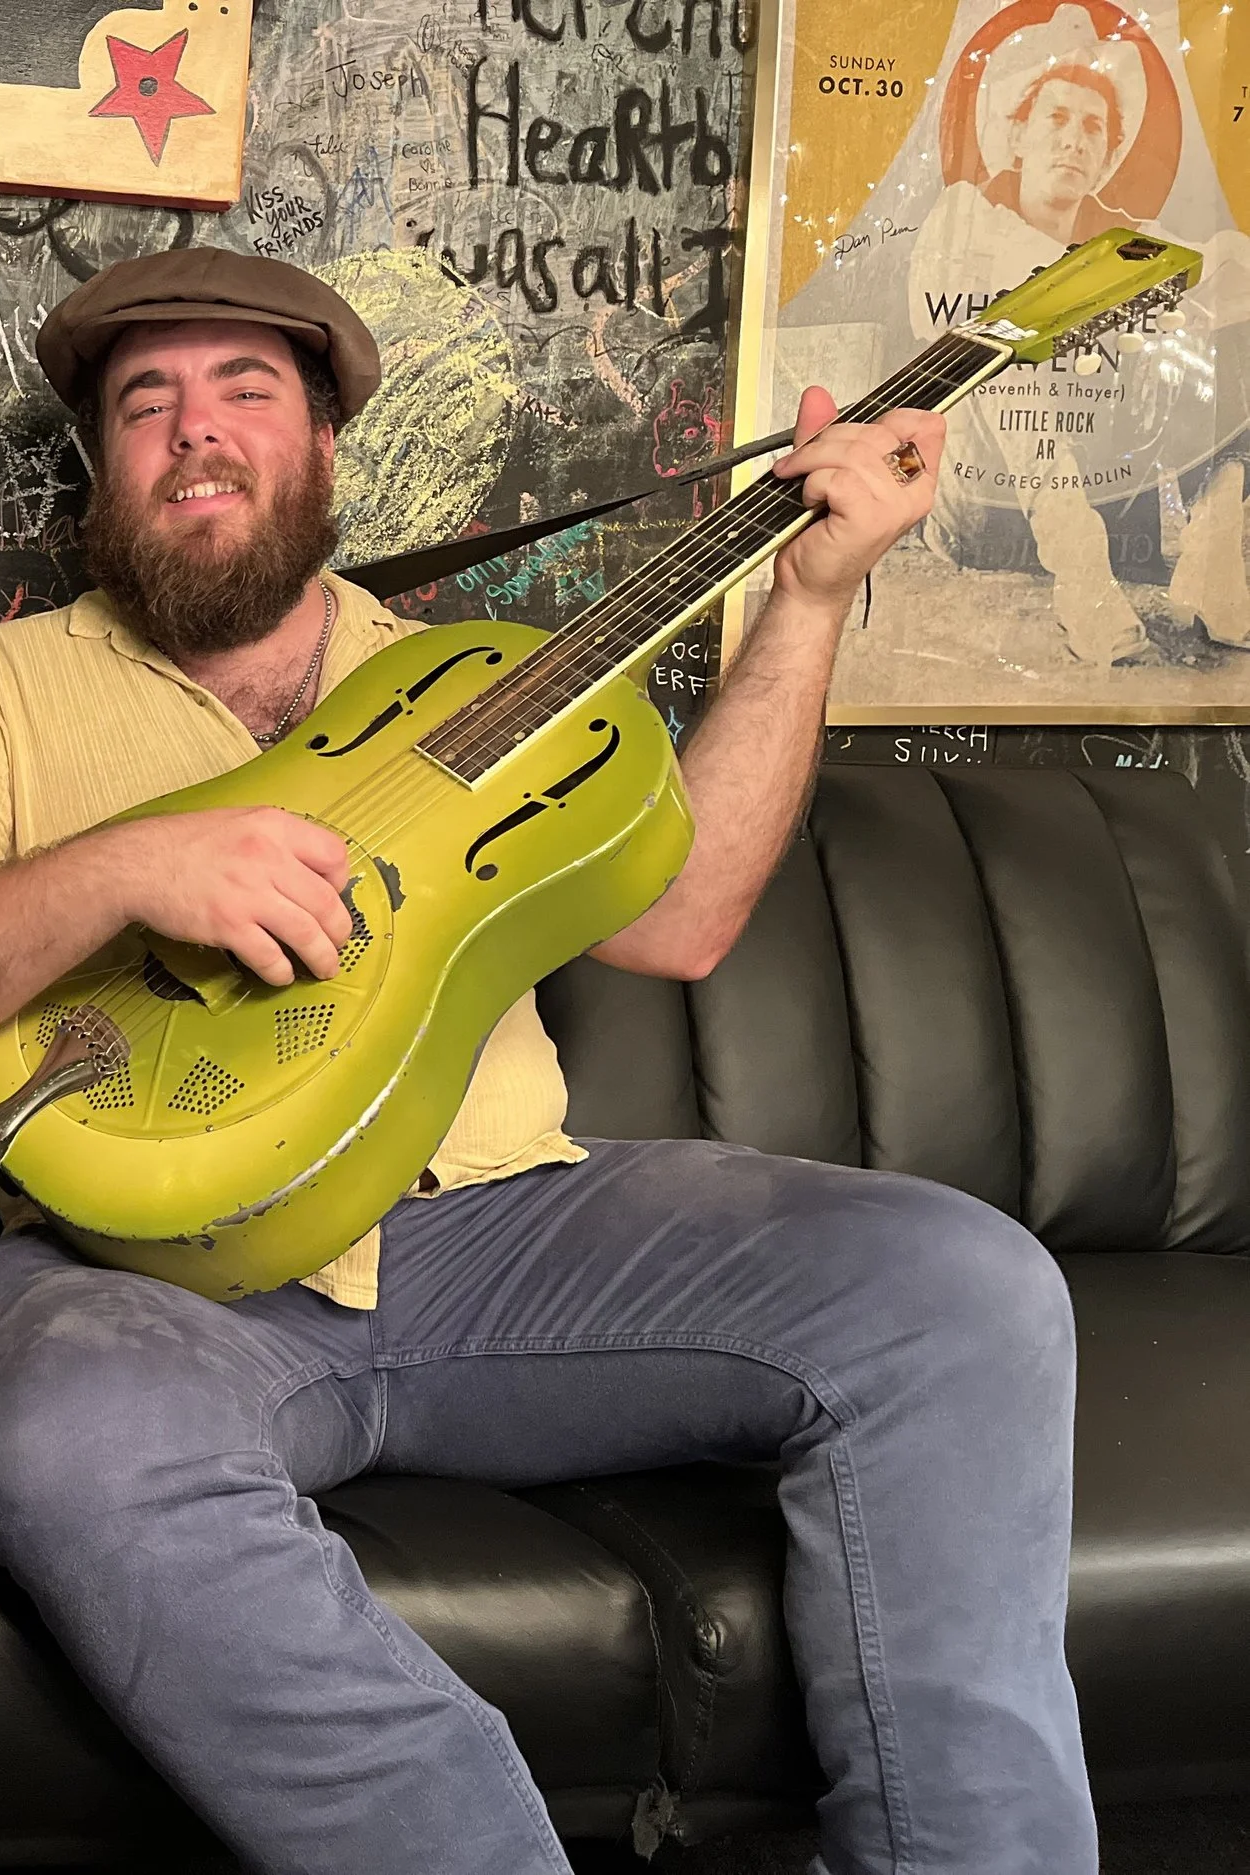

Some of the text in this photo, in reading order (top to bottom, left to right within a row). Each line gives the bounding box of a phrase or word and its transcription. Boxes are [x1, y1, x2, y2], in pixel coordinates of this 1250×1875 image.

[829, 54, 897, 72] SUNDAY
[325, 60, 424, 101] Joseph
[818, 76, 904, 98] OCT. 30
[252, 210, 325, 258] FRIENDS
[1048, 384, 1060, 397] &
[1066, 382, 1126, 402] Thayer)
[999, 409, 1096, 434] LITTLE ROCK
[1036, 438, 1056, 460] AR
[953, 462, 1133, 491] REV GREG SPRADLIN
